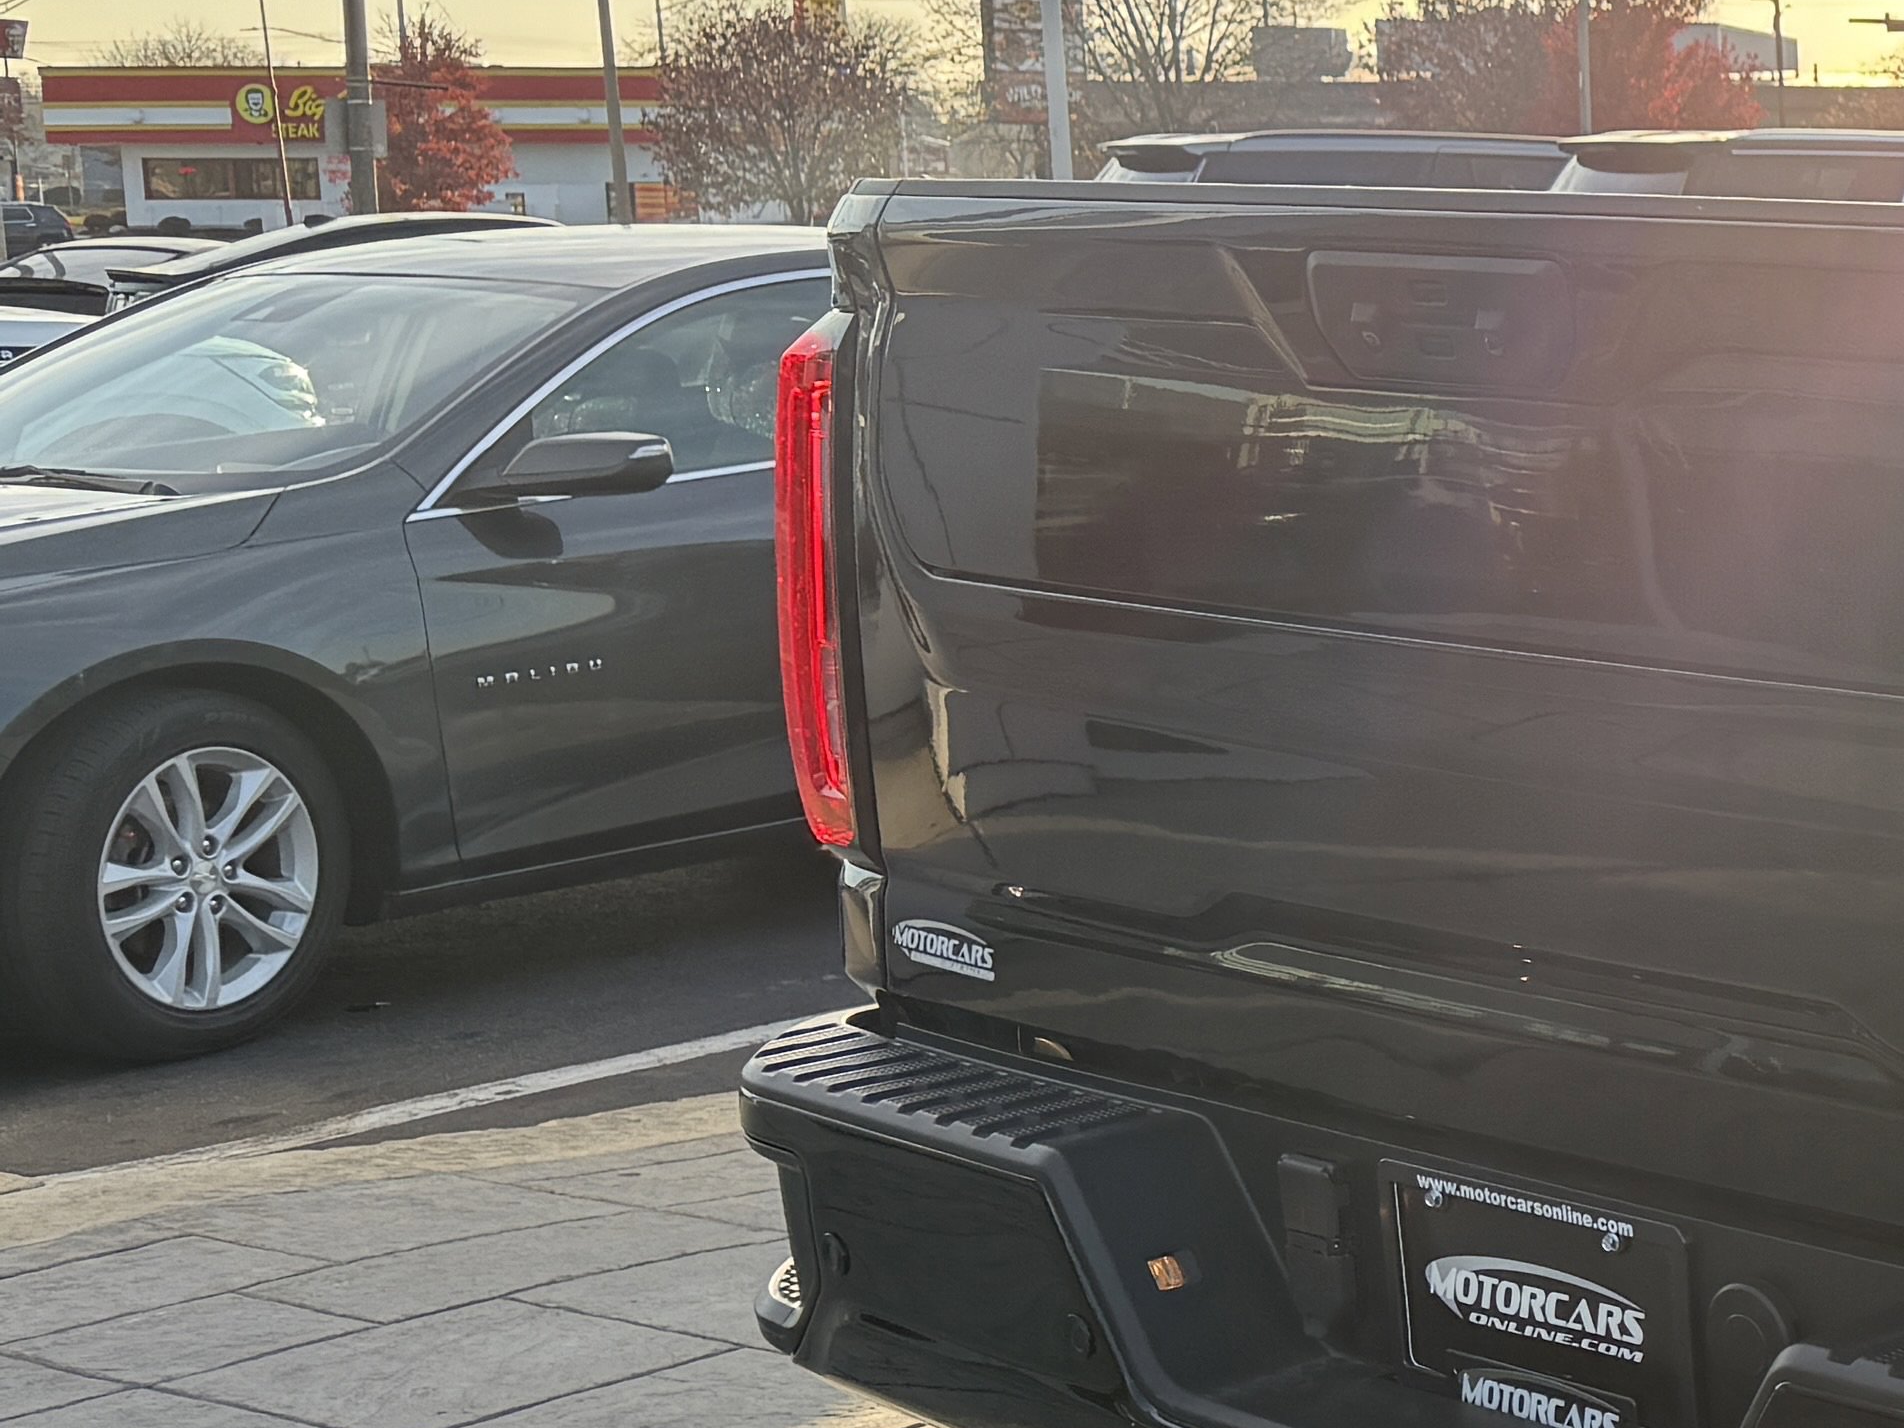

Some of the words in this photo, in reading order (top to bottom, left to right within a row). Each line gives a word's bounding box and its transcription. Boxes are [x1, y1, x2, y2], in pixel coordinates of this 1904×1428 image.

[285, 85, 326, 121] Big
[476, 658, 605, 689] MALIBU
[893, 923, 995, 970] MOTORCARS
[1416, 1173, 1635, 1238] www.motorcarsonline.com
[1428, 1258, 1647, 1347] MOTORCARS
[1468, 1310, 1646, 1365] ONLINE.COM
